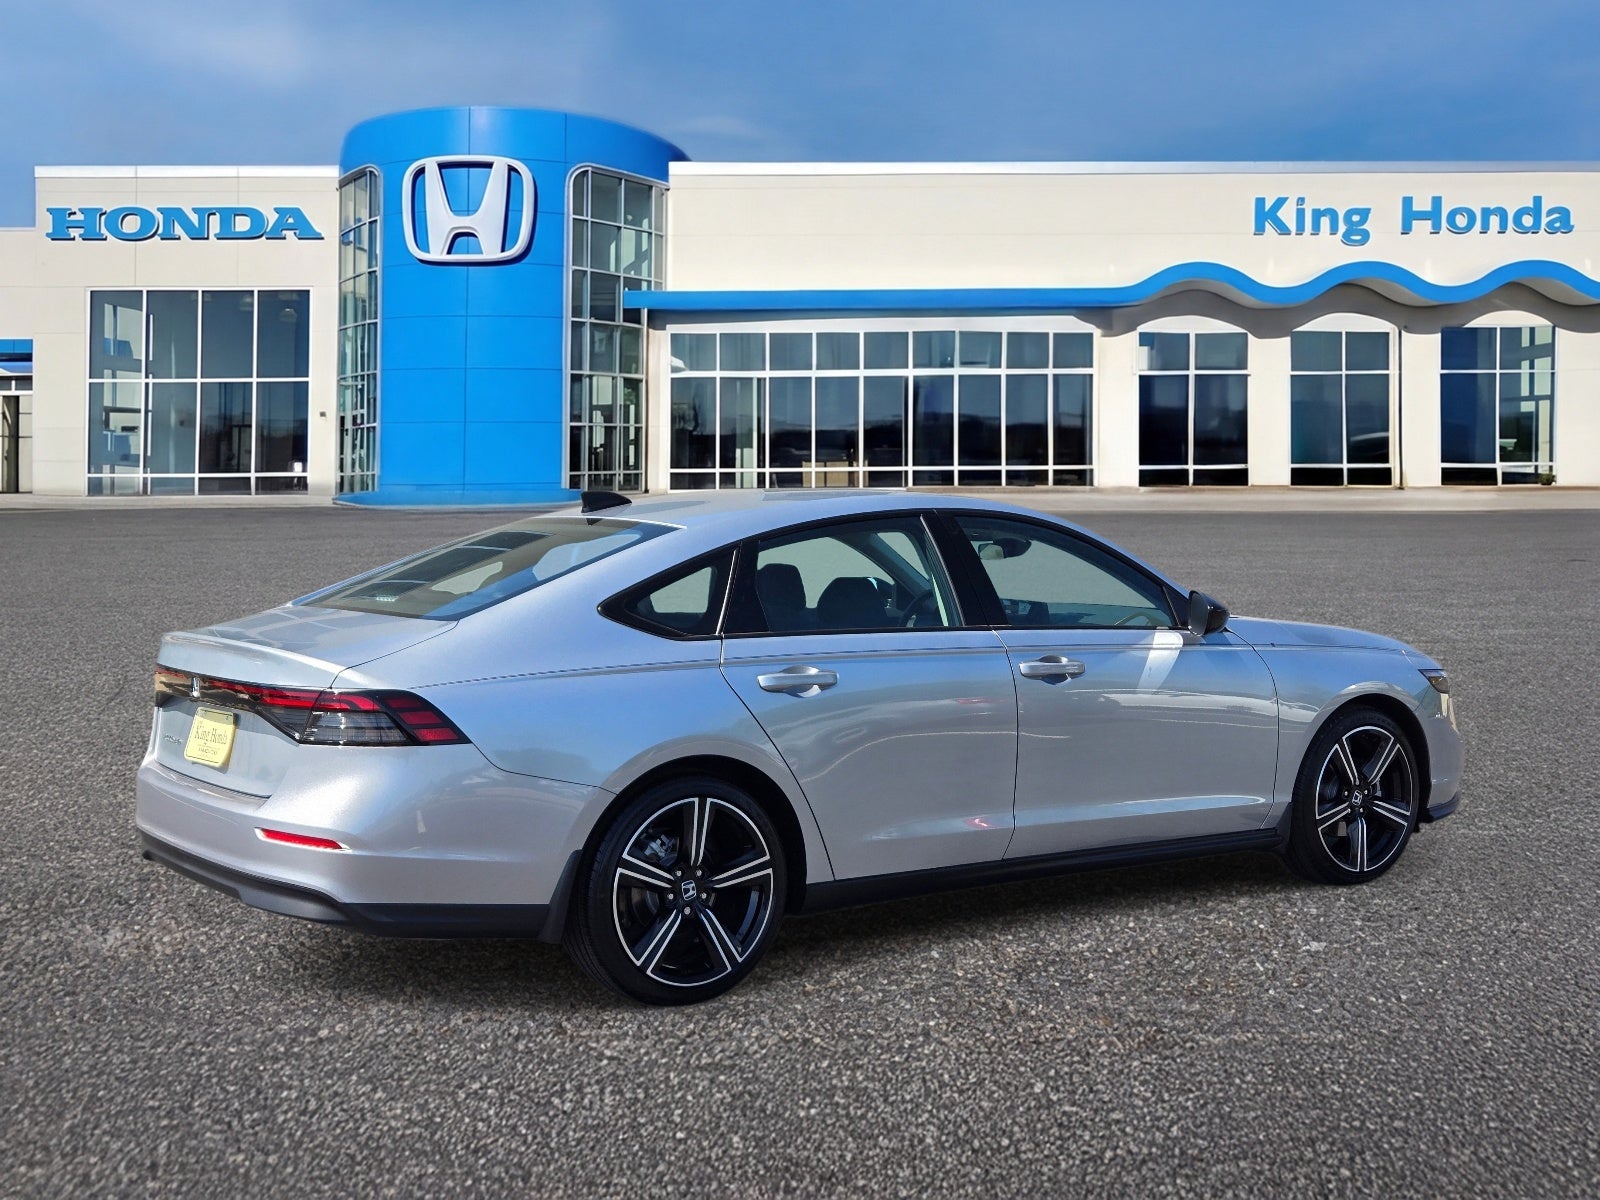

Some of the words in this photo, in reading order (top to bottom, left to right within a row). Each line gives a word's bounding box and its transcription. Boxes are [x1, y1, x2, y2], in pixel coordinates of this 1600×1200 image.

[46, 206, 323, 241] HONDA
[1253, 195, 1371, 245] King
[1401, 195, 1574, 234] Honda
